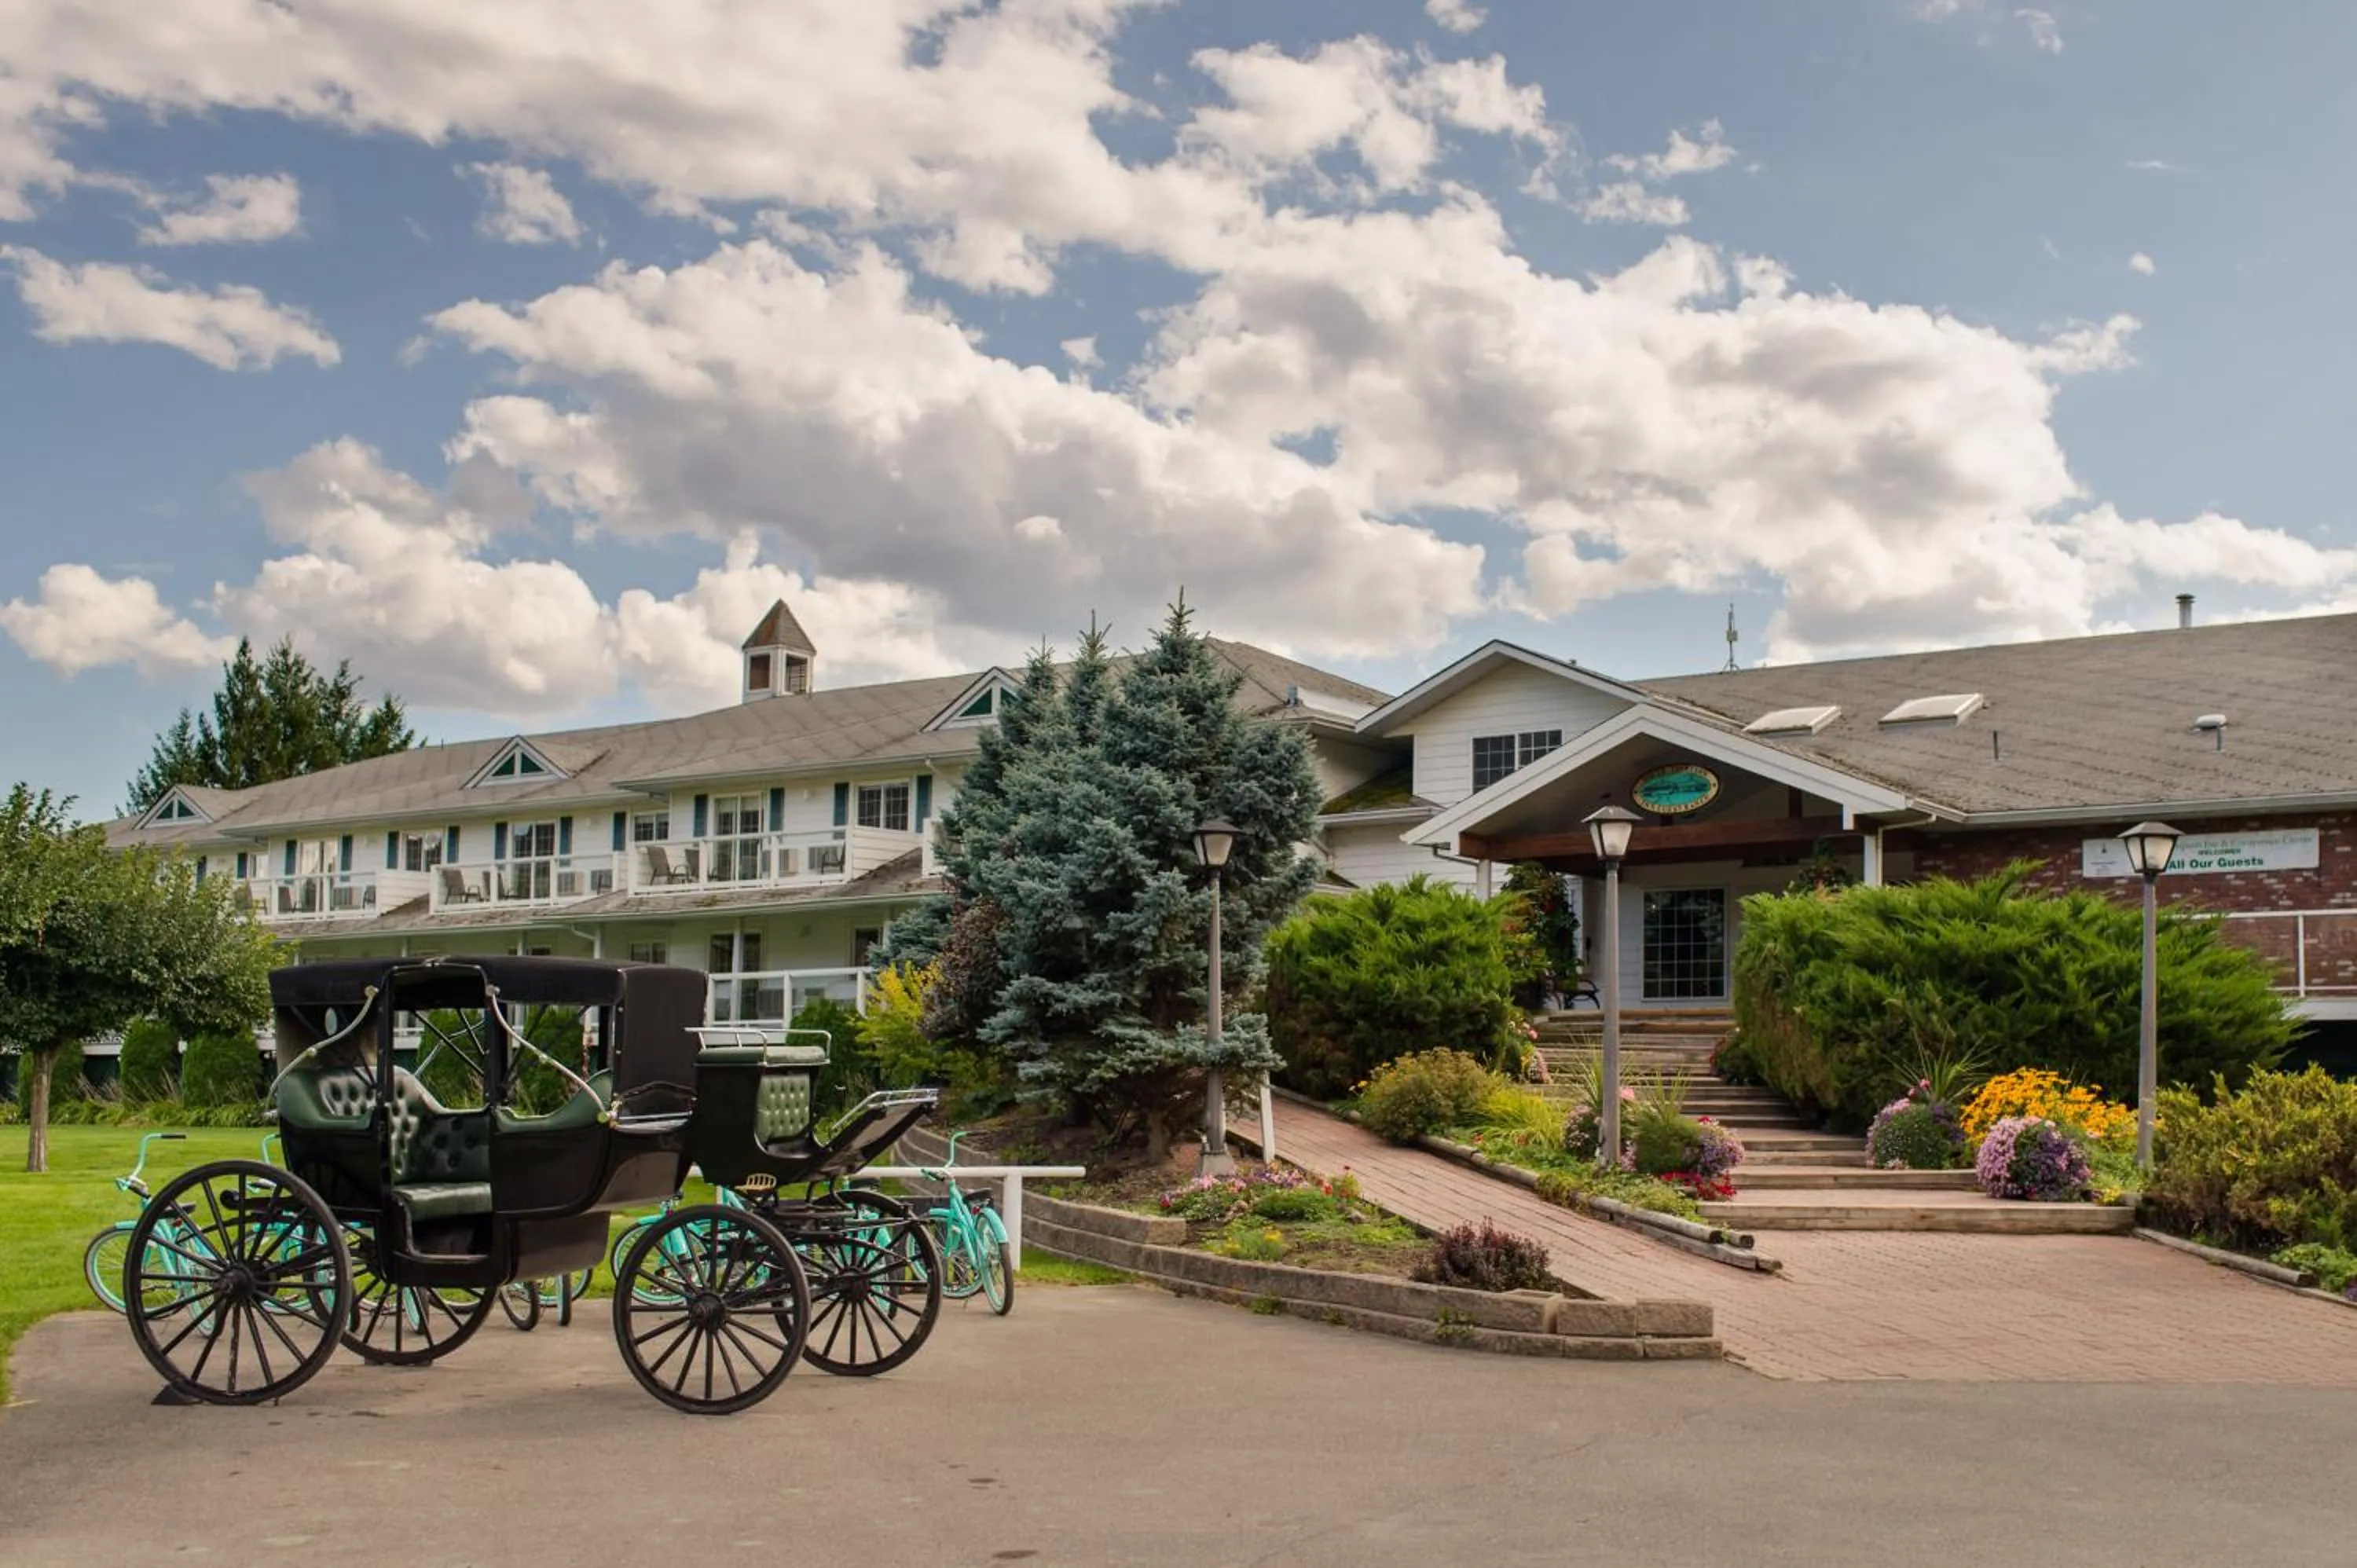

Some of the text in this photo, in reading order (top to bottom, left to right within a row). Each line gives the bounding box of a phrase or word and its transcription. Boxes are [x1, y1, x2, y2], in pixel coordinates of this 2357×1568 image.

[2168, 856, 2264, 870] All Our Guests
